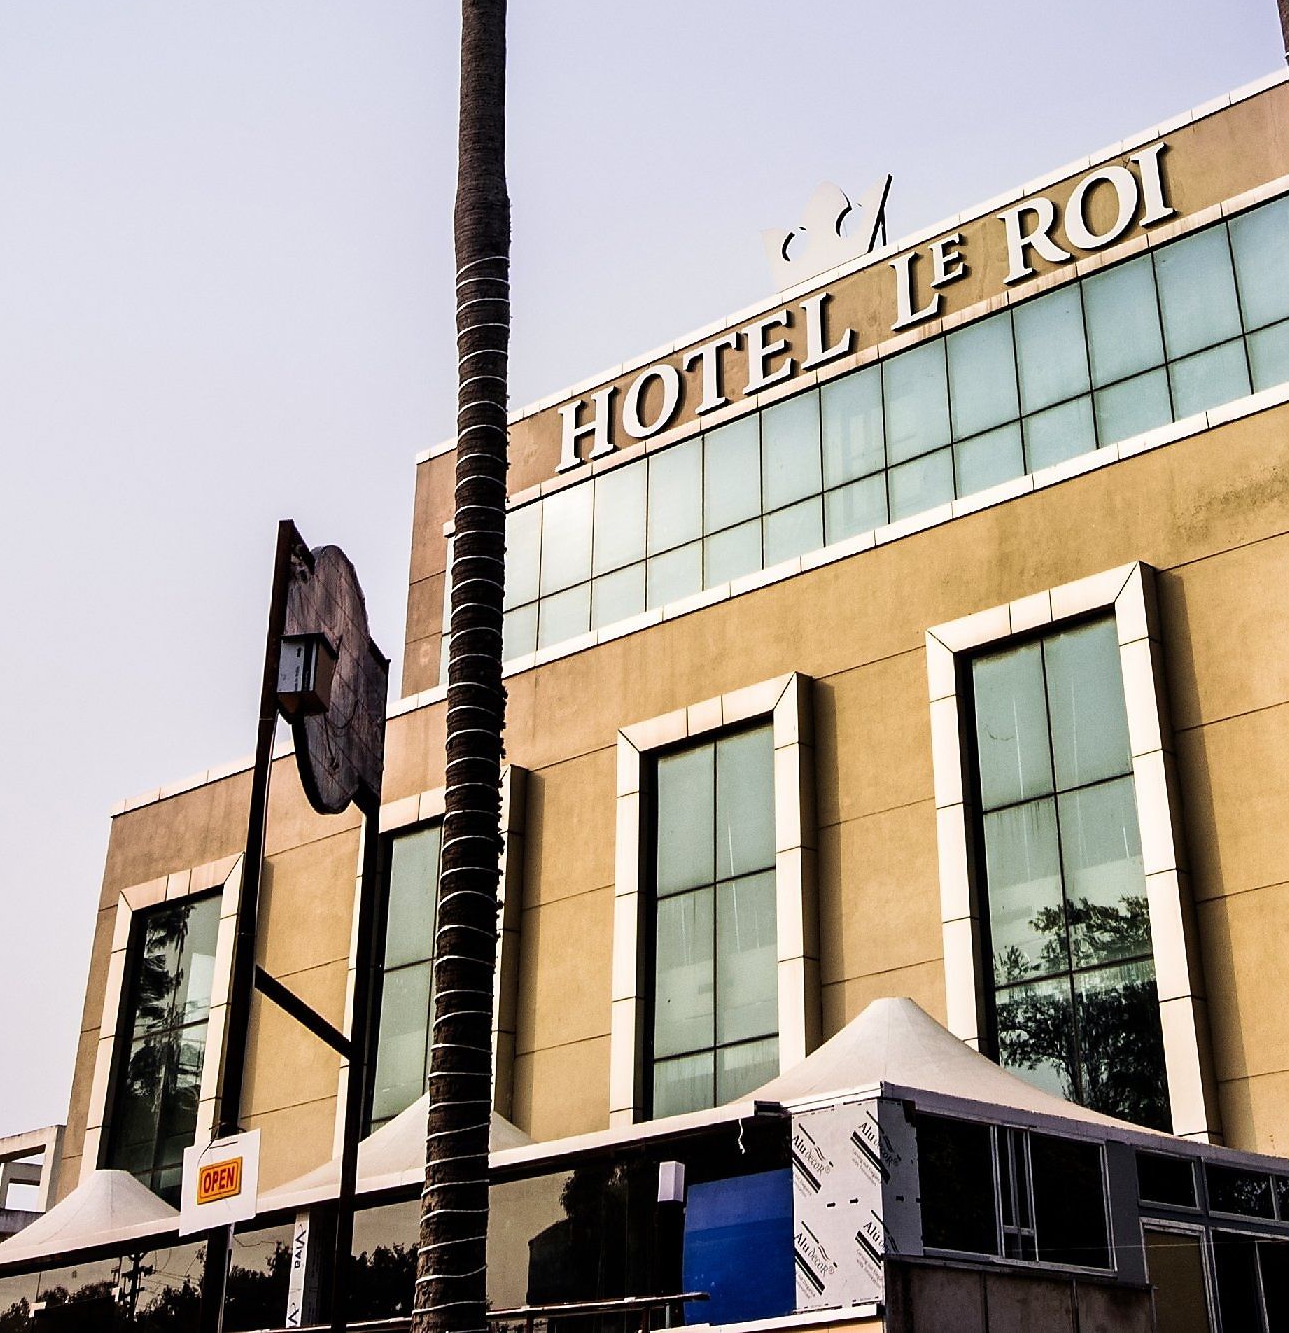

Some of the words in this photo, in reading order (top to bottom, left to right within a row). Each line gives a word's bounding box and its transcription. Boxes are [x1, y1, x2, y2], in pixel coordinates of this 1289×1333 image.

[556, 292, 853, 473] HOTEL
[997, 142, 1176, 284] ROI
[203, 1167, 236, 1194] OPEN
